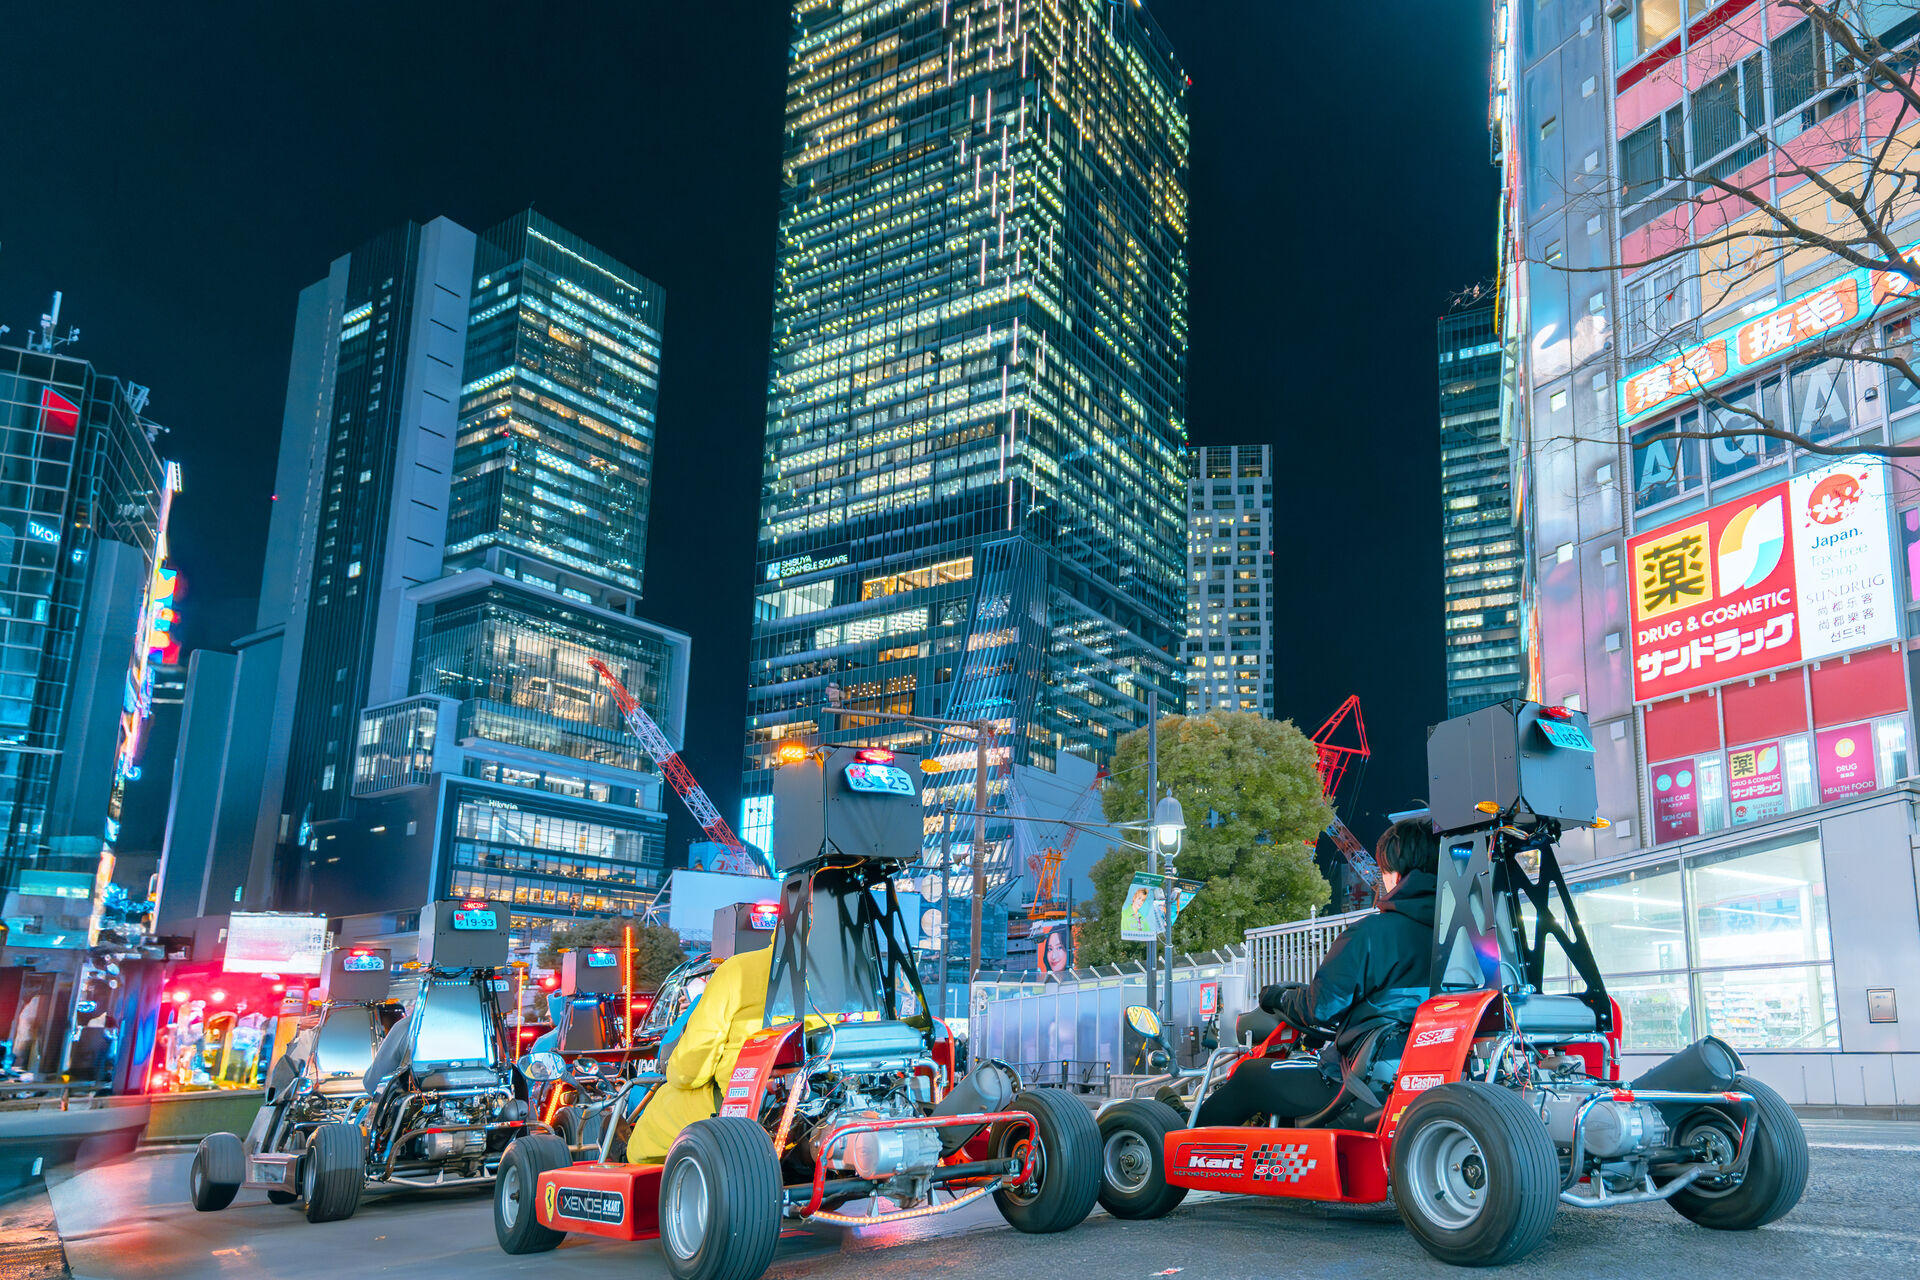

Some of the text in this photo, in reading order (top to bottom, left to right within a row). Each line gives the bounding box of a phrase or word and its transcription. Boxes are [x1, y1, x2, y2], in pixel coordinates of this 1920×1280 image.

[1811, 527, 1863, 549] Japan.
[780, 555, 812, 569] SHIBUYA
[780, 554, 848, 578] SCRAMBLE SQUARE
[1642, 534, 1706, 612] 薬
[1821, 563, 1858, 580] Shop
[1806, 573, 1885, 604] SUNDRUG
[1638, 588, 1791, 646] DRUG & COSMETIC
[1637, 612, 1795, 682] サンドラッグ
[1732, 753, 1754, 777] 薬
[1836, 763, 1858, 773] DRUG
[1731, 781, 1781, 799] サンドラッグ
[1824, 784, 1850, 795] HEALTH
[1851, 780, 1875, 790] FOOD
[1660, 793, 1691, 804] HAIR CARE
[1675, 811, 1692, 819] CARE
[1410, 1075, 1443, 1089] Castrol
[1188, 1155, 1244, 1170] Kart
[1254, 1164, 1285, 1176] 50
[1173, 1170, 1246, 1179] streetpower
[563, 1195, 602, 1213] XENOS
